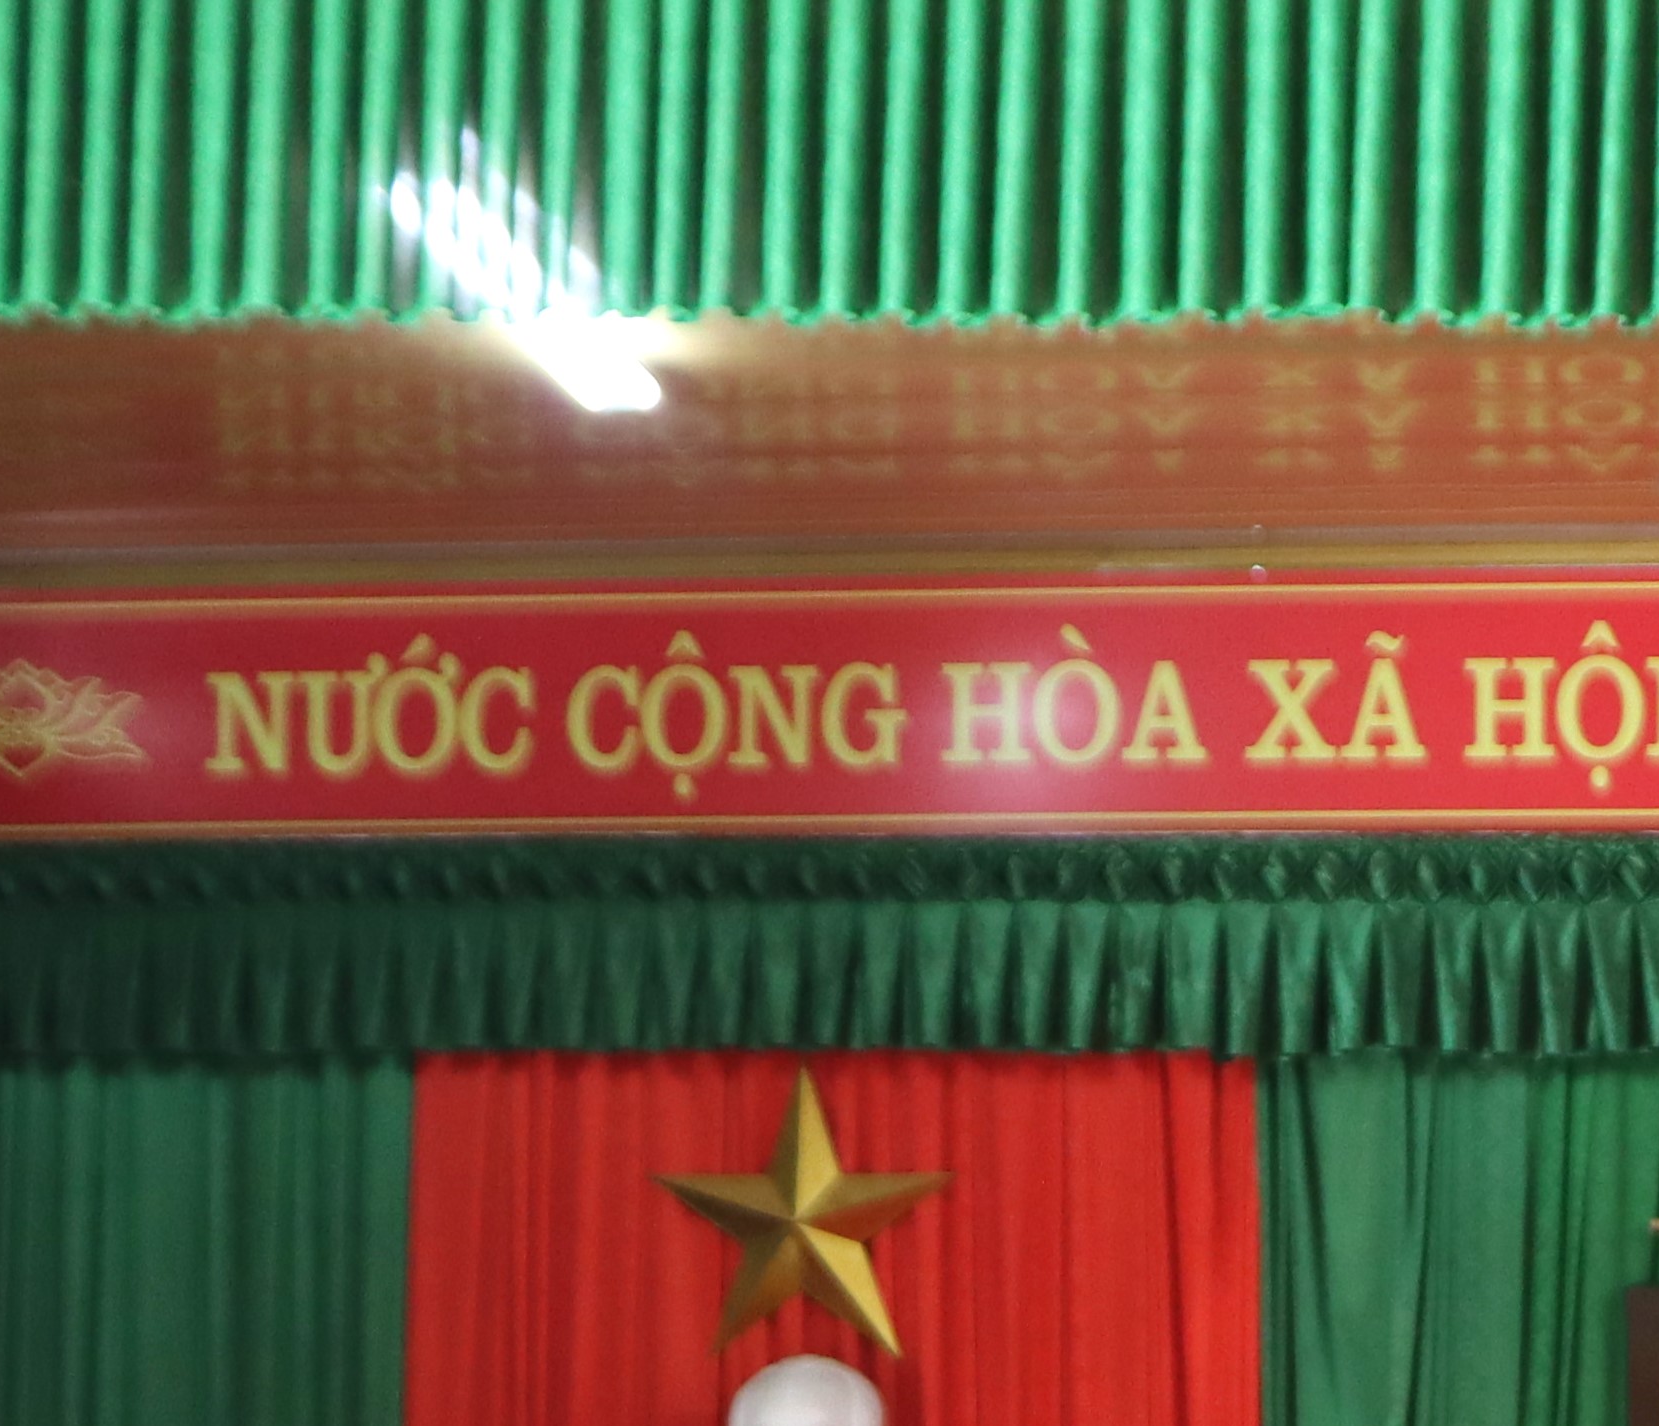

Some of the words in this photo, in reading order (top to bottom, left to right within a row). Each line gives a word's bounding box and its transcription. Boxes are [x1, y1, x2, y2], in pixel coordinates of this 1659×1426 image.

[206, 634, 531, 774] NƯỚC
[569, 632, 906, 796] CỘNG
[943, 625, 1208, 766] HÒA
[1245, 631, 1426, 763] XÃ
